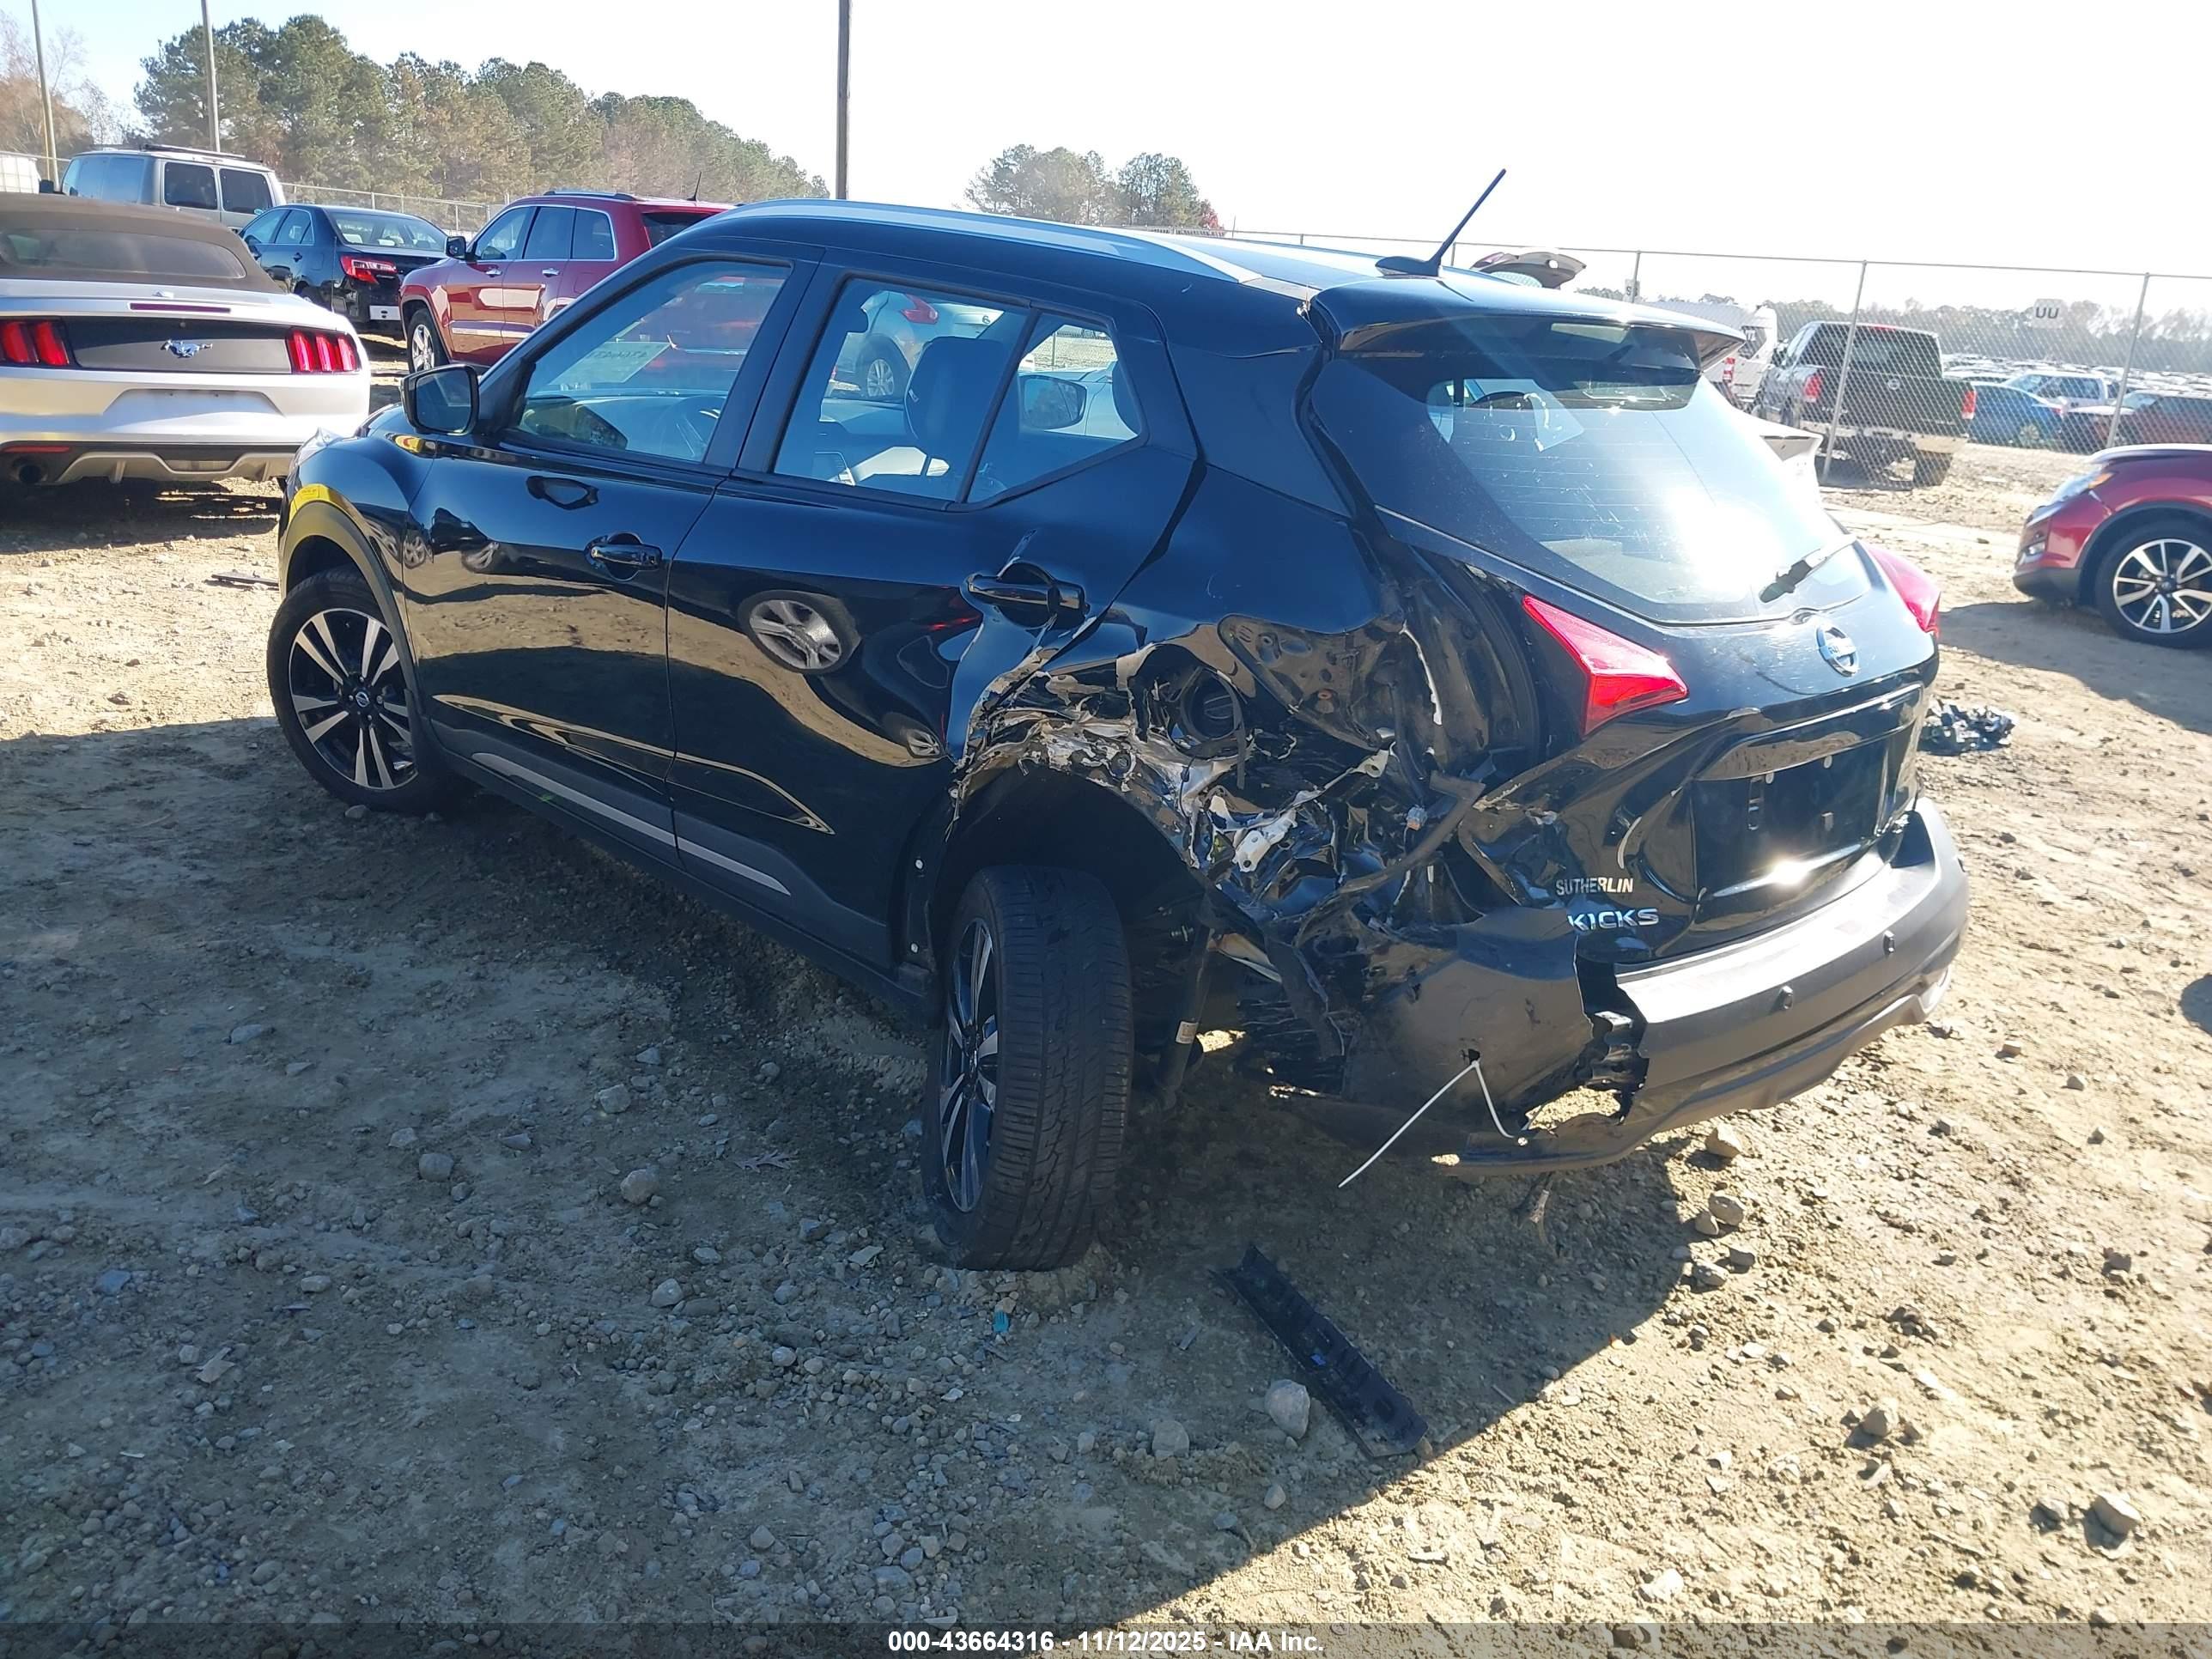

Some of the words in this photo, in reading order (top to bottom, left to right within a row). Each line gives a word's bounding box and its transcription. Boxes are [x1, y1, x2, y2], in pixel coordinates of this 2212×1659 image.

[2036, 307, 2060, 319] UU
[1556, 877, 1634, 896] SUTHERLIN
[1567, 908, 1660, 932] KICKS
